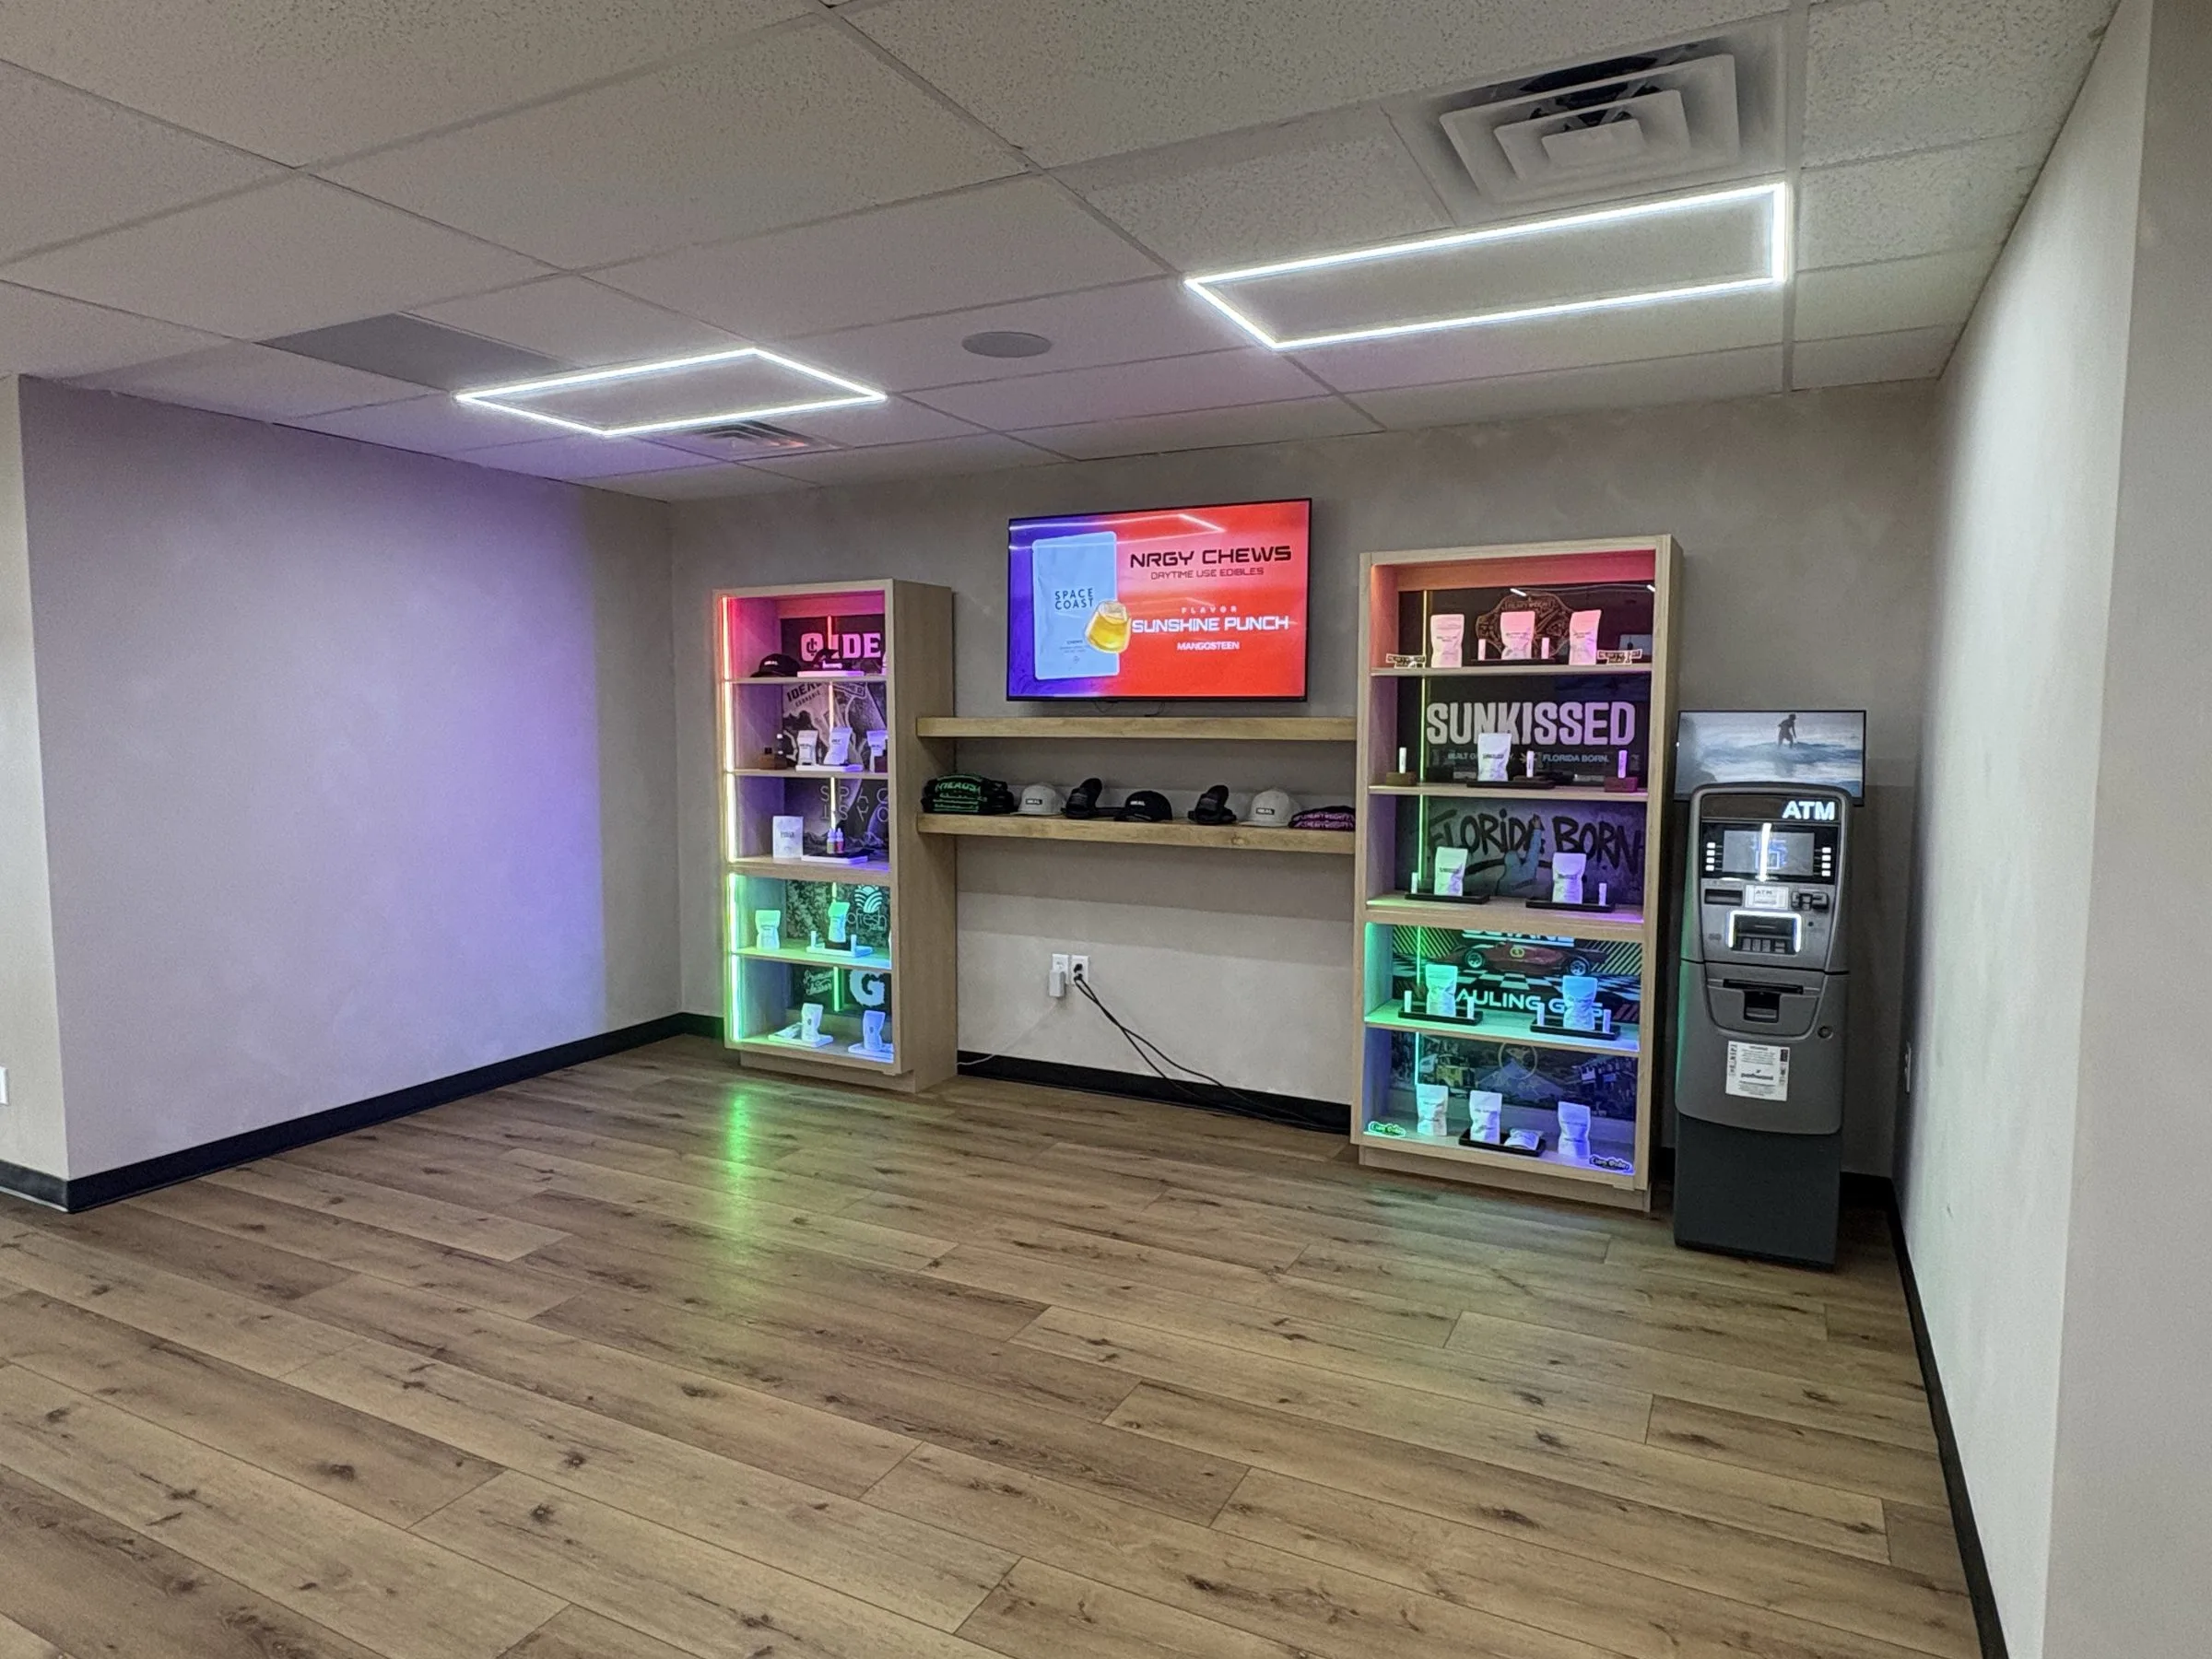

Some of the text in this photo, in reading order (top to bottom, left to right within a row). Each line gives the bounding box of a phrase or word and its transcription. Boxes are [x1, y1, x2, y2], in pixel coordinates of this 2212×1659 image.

[1130, 546, 1292, 569] NRGY CHEWS
[1150, 567, 1265, 581] DAYTIME USE EDIBLES
[1054, 587, 1093, 601] SPACE
[1054, 597, 1094, 610] COAST
[1181, 605, 1238, 614] FLAVOR
[1132, 616, 1289, 633] SUNSHINE PUNCH
[1177, 641, 1240, 651] MANGOSTEEN
[1427, 701, 1636, 745] SUNKISSED
[1542, 752, 1579, 762] FLORIDA
[1782, 800, 1835, 820] ATM
[1552, 816, 1644, 876] BORN
